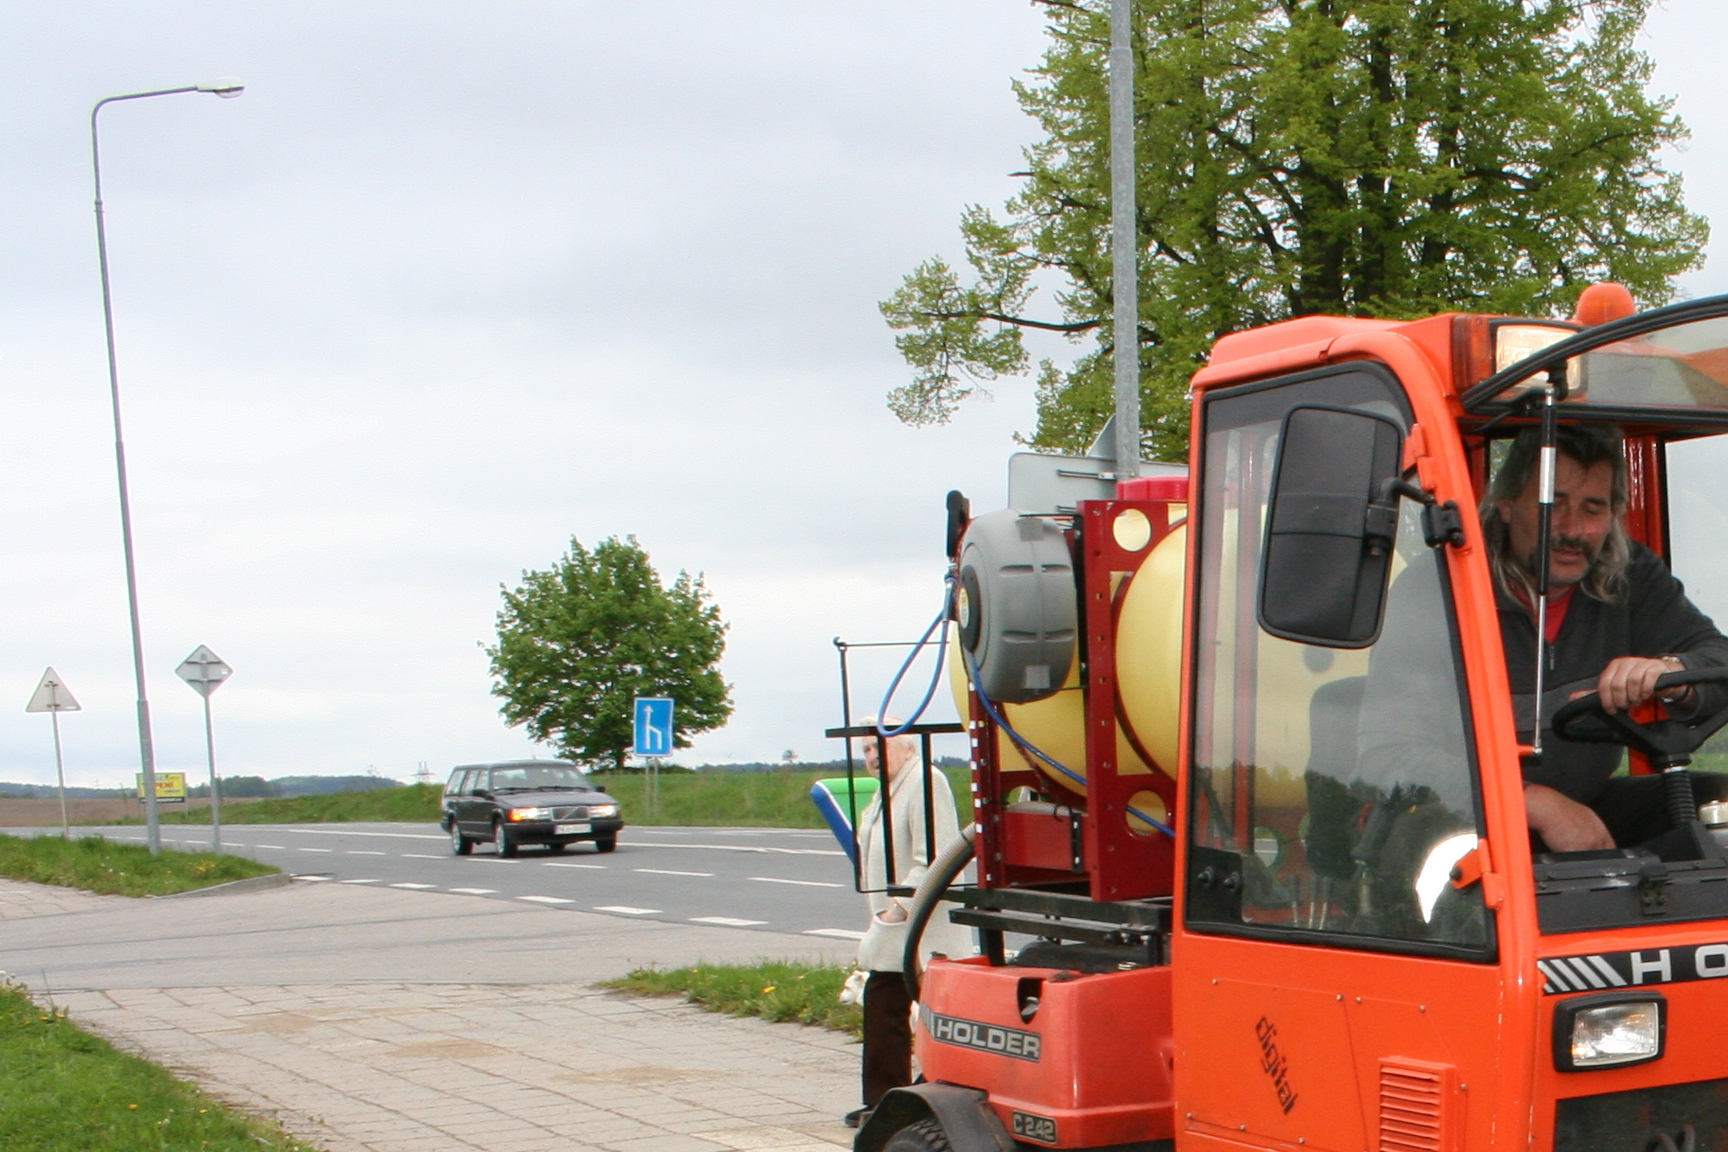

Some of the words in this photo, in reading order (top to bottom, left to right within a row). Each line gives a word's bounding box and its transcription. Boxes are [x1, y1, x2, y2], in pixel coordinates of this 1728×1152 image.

[936, 1018, 1042, 1059] HOLDER
[1255, 1016, 1299, 1116] digital
[1013, 1113, 1023, 1134] C
